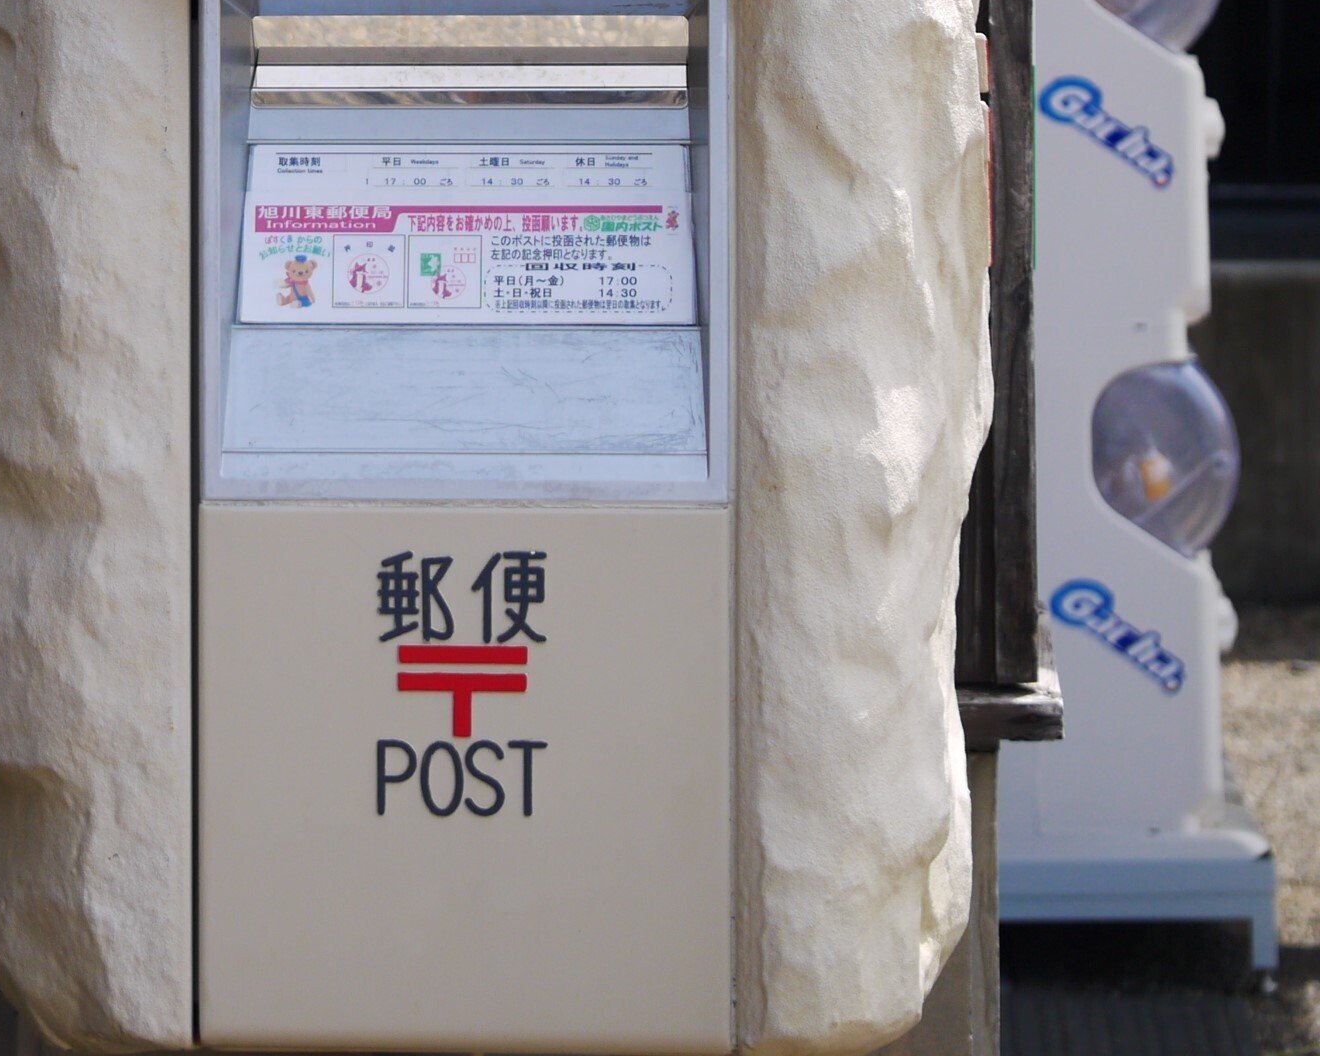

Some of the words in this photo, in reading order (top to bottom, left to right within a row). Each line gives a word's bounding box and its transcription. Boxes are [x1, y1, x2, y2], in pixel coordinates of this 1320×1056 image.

[278, 156, 321, 167] 取集時刻
[382, 156, 402, 166] 平日
[479, 156, 510, 167] 土曜日
[575, 156, 596, 167] 休日
[257, 205, 393, 220] 旭川東郵便局
[265, 219, 377, 230] Information
[600, 221, 663, 232] 園内ポスト
[490, 234, 652, 247] このポストに投函された郵便物は
[490, 248, 613, 261] 左記の記念押印となります。
[524, 262, 637, 271] 回収時刻
[376, 549, 547, 644] 郵便
[376, 739, 549, 816] POST
